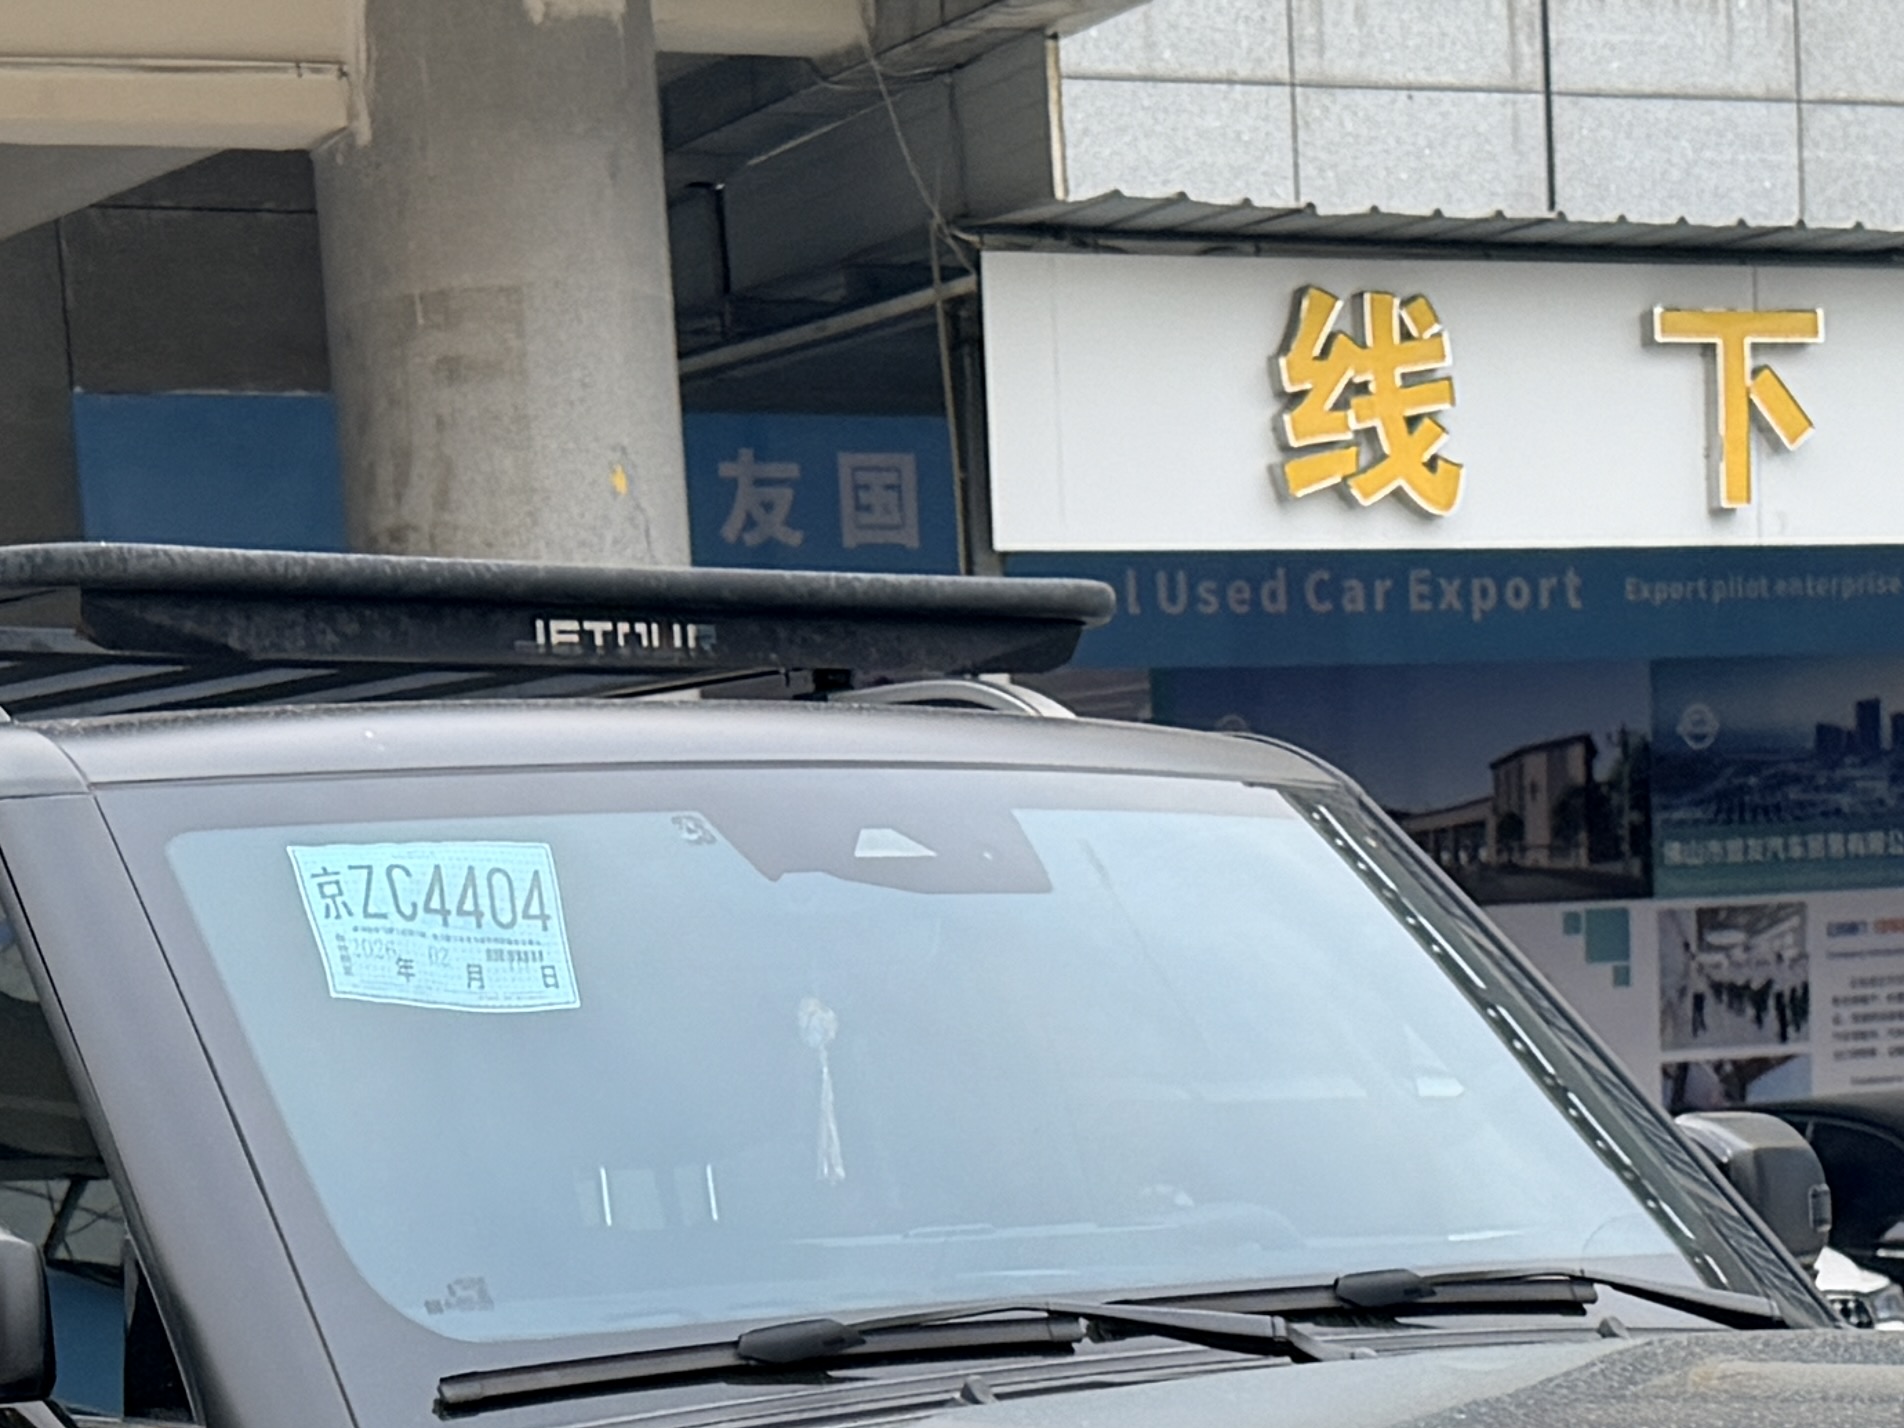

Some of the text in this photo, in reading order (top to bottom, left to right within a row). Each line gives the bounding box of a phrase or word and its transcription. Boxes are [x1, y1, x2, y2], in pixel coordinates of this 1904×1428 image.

[718, 446, 922, 549] 友国
[1157, 569, 1289, 616] Used
[1304, 569, 1393, 615] Car
[1408, 566, 1584, 622] Export
[1624, 576, 1707, 606] Export
[310, 863, 551, 932] 京ZC4404
[394, 956, 417, 983] 年
[465, 962, 486, 990] 月
[540, 964, 561, 990] 日
